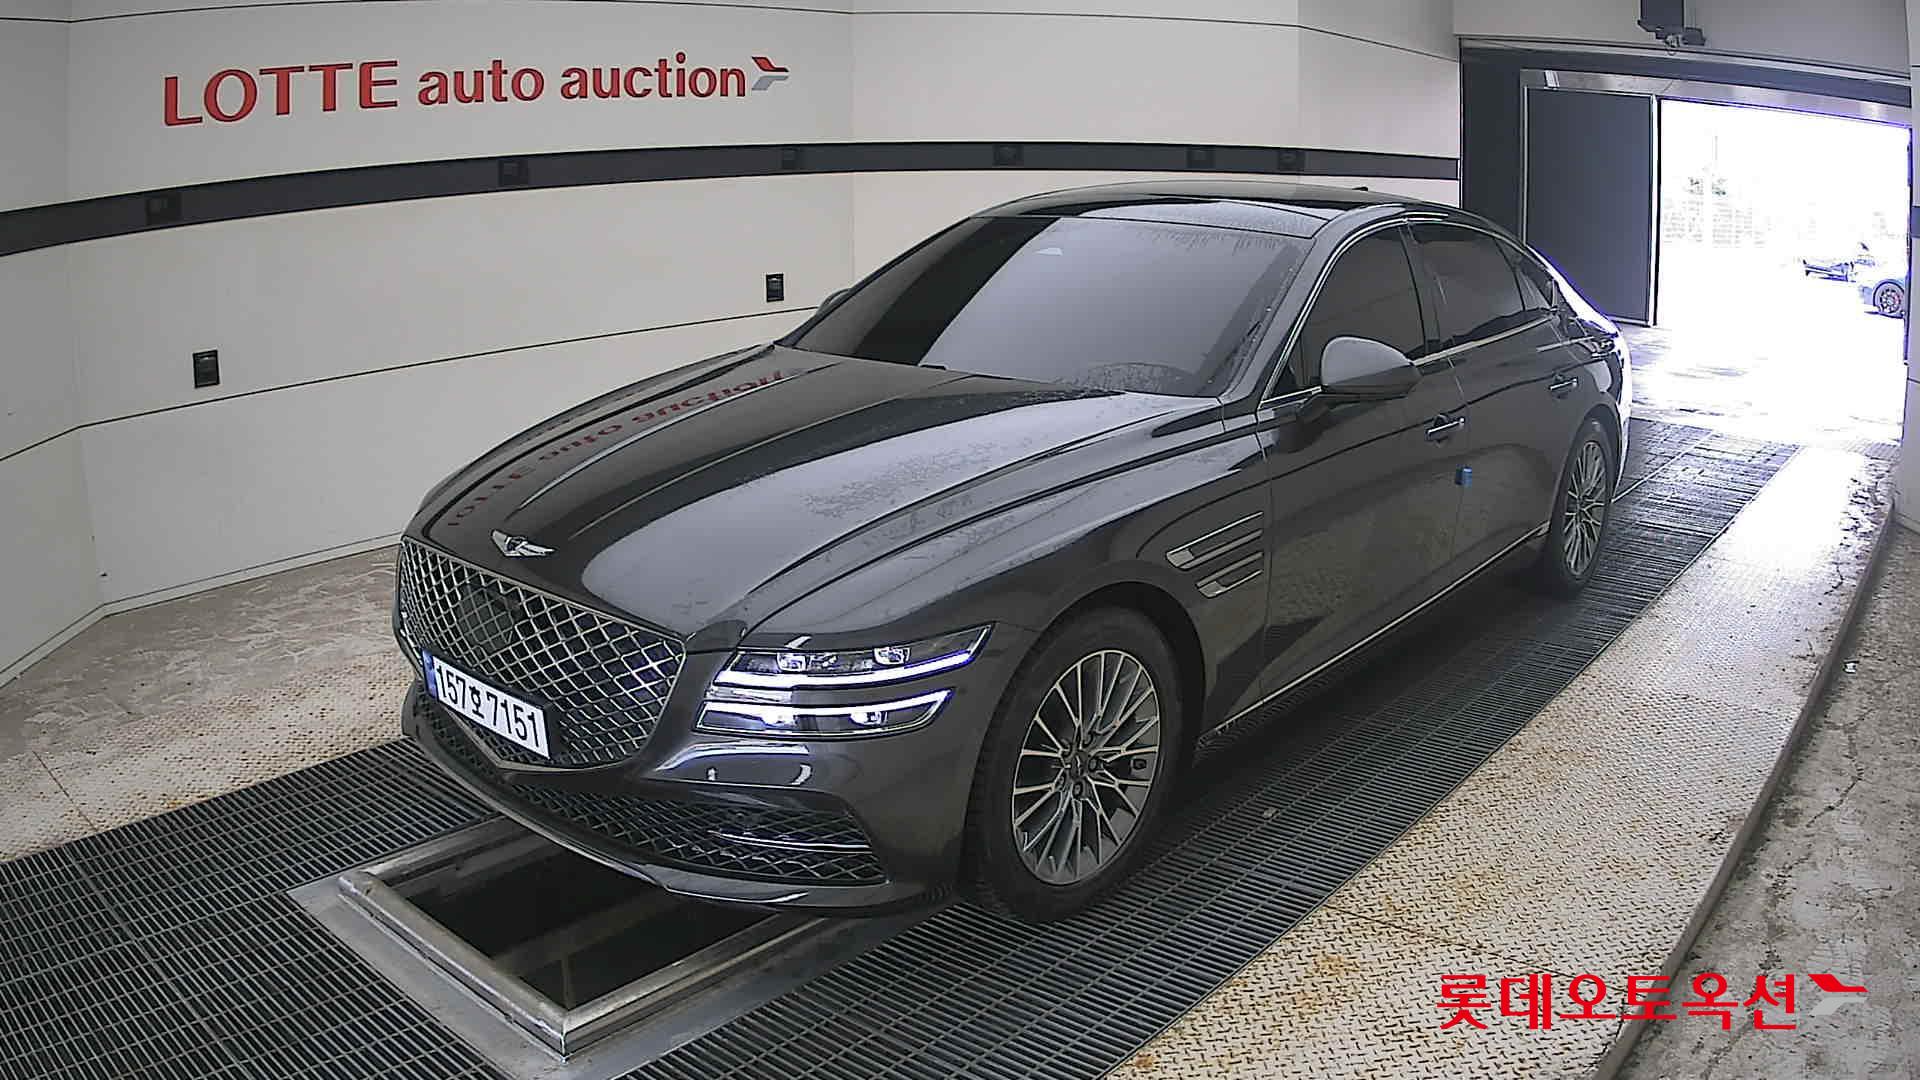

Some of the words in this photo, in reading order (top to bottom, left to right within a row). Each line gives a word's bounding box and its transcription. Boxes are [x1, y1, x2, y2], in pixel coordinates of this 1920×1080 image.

[163, 59, 399, 127] LOTTE
[417, 58, 545, 105] auto
[560, 51, 747, 99] auction
